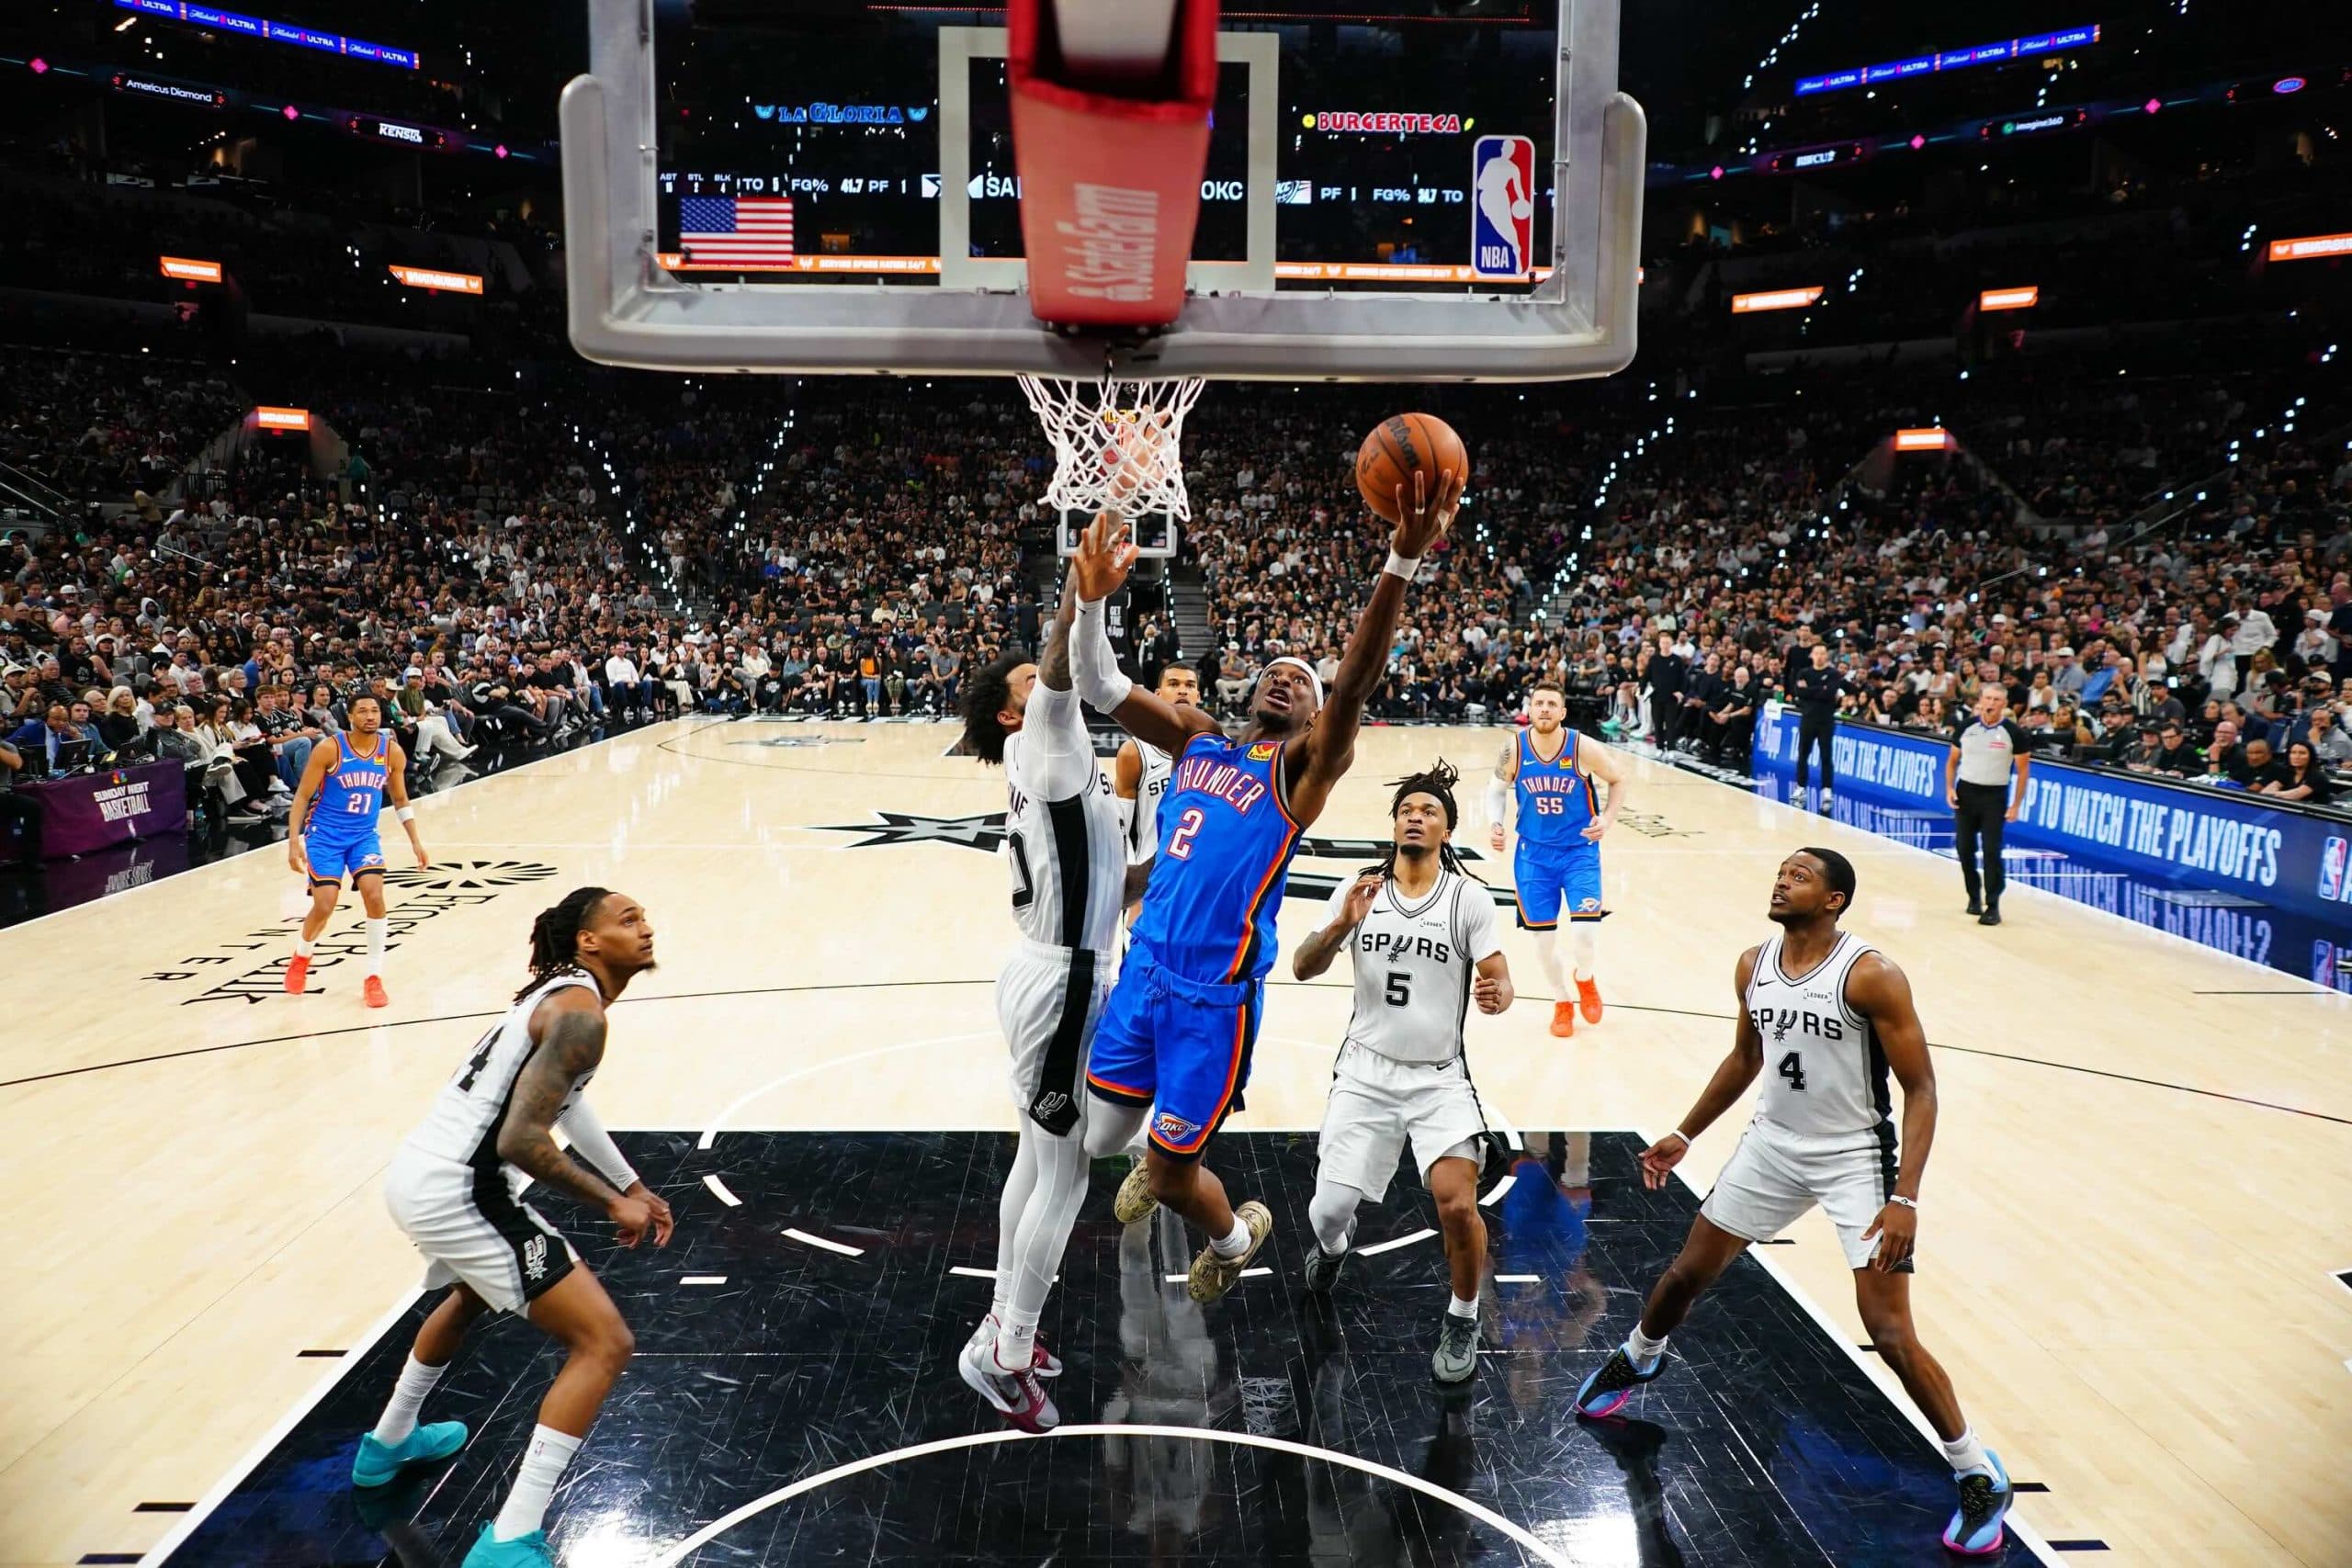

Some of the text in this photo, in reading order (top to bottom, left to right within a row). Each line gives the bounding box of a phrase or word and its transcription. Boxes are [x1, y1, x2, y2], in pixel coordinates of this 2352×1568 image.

[227, 17, 256, 30] ULTRA
[306, 34, 335, 47] ULTRA
[2057, 32, 2086, 45] ULTRA
[382, 51, 408, 63] ULTRA
[126, 79, 212, 103] Americus Diamond
[778, 102, 904, 124] LA GLORIA
[1317, 111, 1462, 133] BURGERTECA
[742, 177, 763, 191] TO
[791, 178, 829, 192] FG%
[868, 180, 889, 193] PF
[1201, 180, 1243, 201] OKC
[1321, 187, 1342, 200] PF
[1374, 188, 1411, 201] FG%
[1442, 189, 1464, 203] TO
[1481, 245, 1510, 268] NBA
[1855, 739, 1880, 783] THE
[1877, 745, 1938, 797] PLAYOFFS
[93, 785, 127, 802] SUNDAY
[1175, 756, 1266, 815] THUNDER
[1521, 776, 1577, 795] THUNDER
[99, 793, 152, 822] BASKETBALL
[347, 793, 372, 815] 21
[1536, 796, 1564, 815] 55
[1166, 807, 1206, 862] 2
[2041, 780, 2063, 830] TO
[2062, 786, 2128, 848] WATCH
[2127, 800, 2169, 859] THE
[2166, 808, 2282, 887] PLAYOFFS
[1362, 932, 1450, 964] SPURS
[1385, 970, 1412, 1009] 5
[1749, 1008, 1843, 1042] SPURS
[1778, 1050, 1806, 1092] 4
[1159, 1122, 1185, 1132] OKC
